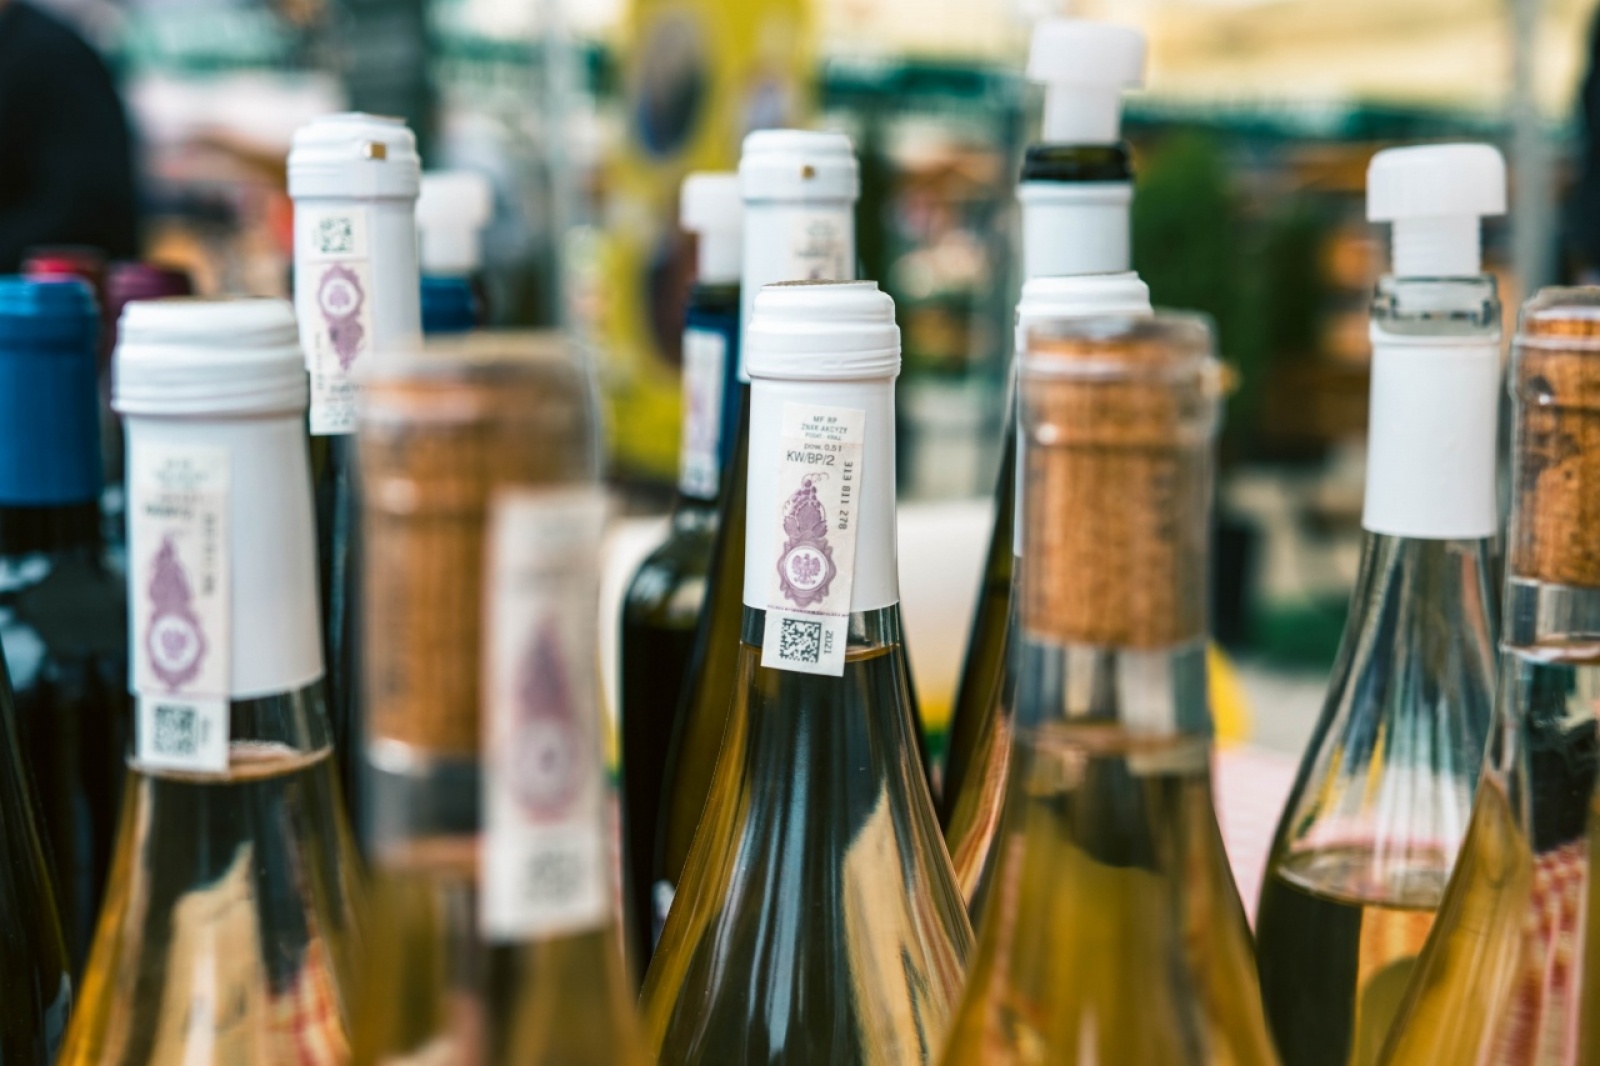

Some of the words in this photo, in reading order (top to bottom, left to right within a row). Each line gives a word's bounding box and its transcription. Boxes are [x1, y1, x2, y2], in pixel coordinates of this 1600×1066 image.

[786, 450, 835, 466] KW/BP/2
[843, 461, 853, 481] 313
[841, 485, 851, 504] 811
[838, 510, 849, 530] 278
[823, 630, 834, 655] 2021
